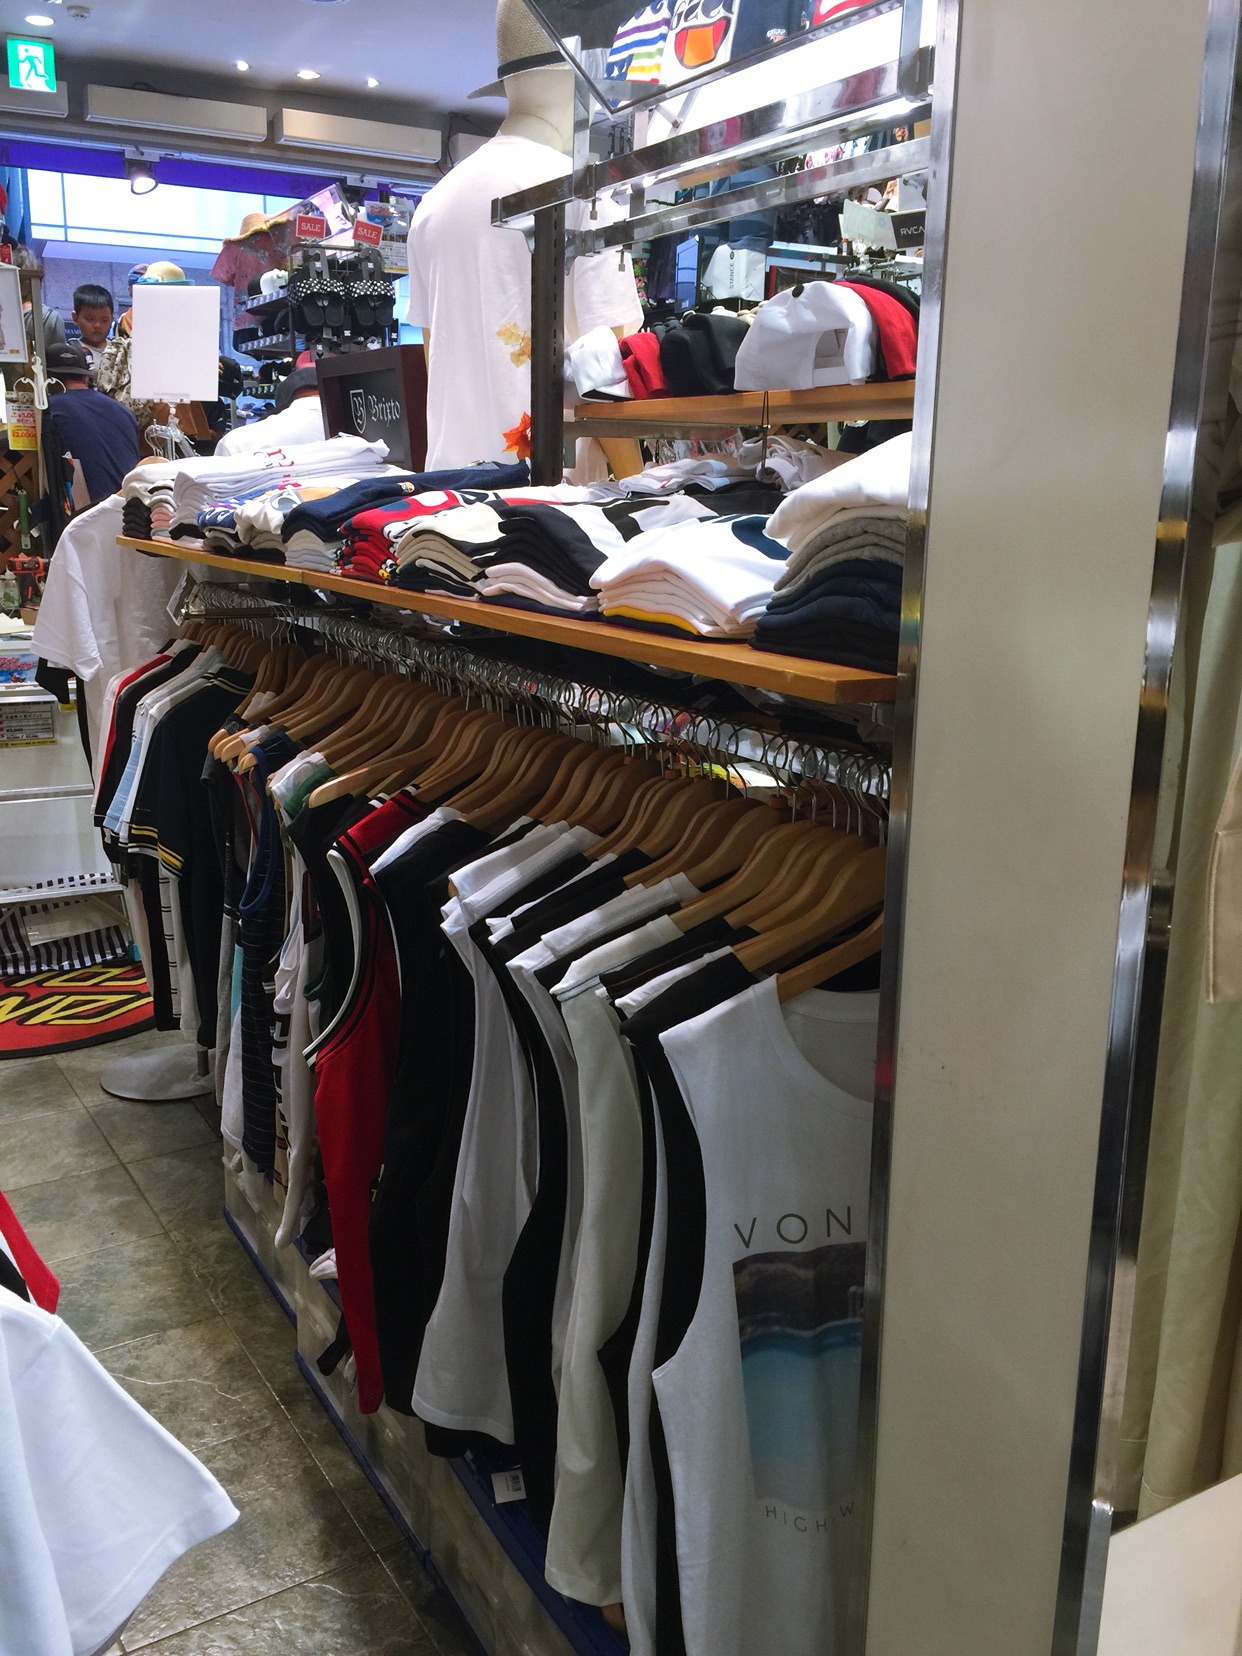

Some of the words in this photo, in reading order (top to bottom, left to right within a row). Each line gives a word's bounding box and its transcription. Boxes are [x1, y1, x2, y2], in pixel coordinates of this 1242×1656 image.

[301, 222, 321, 232] SALE
[357, 227, 378, 239] SALE
[733, 1205, 852, 1250] VON
[765, 1505, 828, 1533] HIGH
